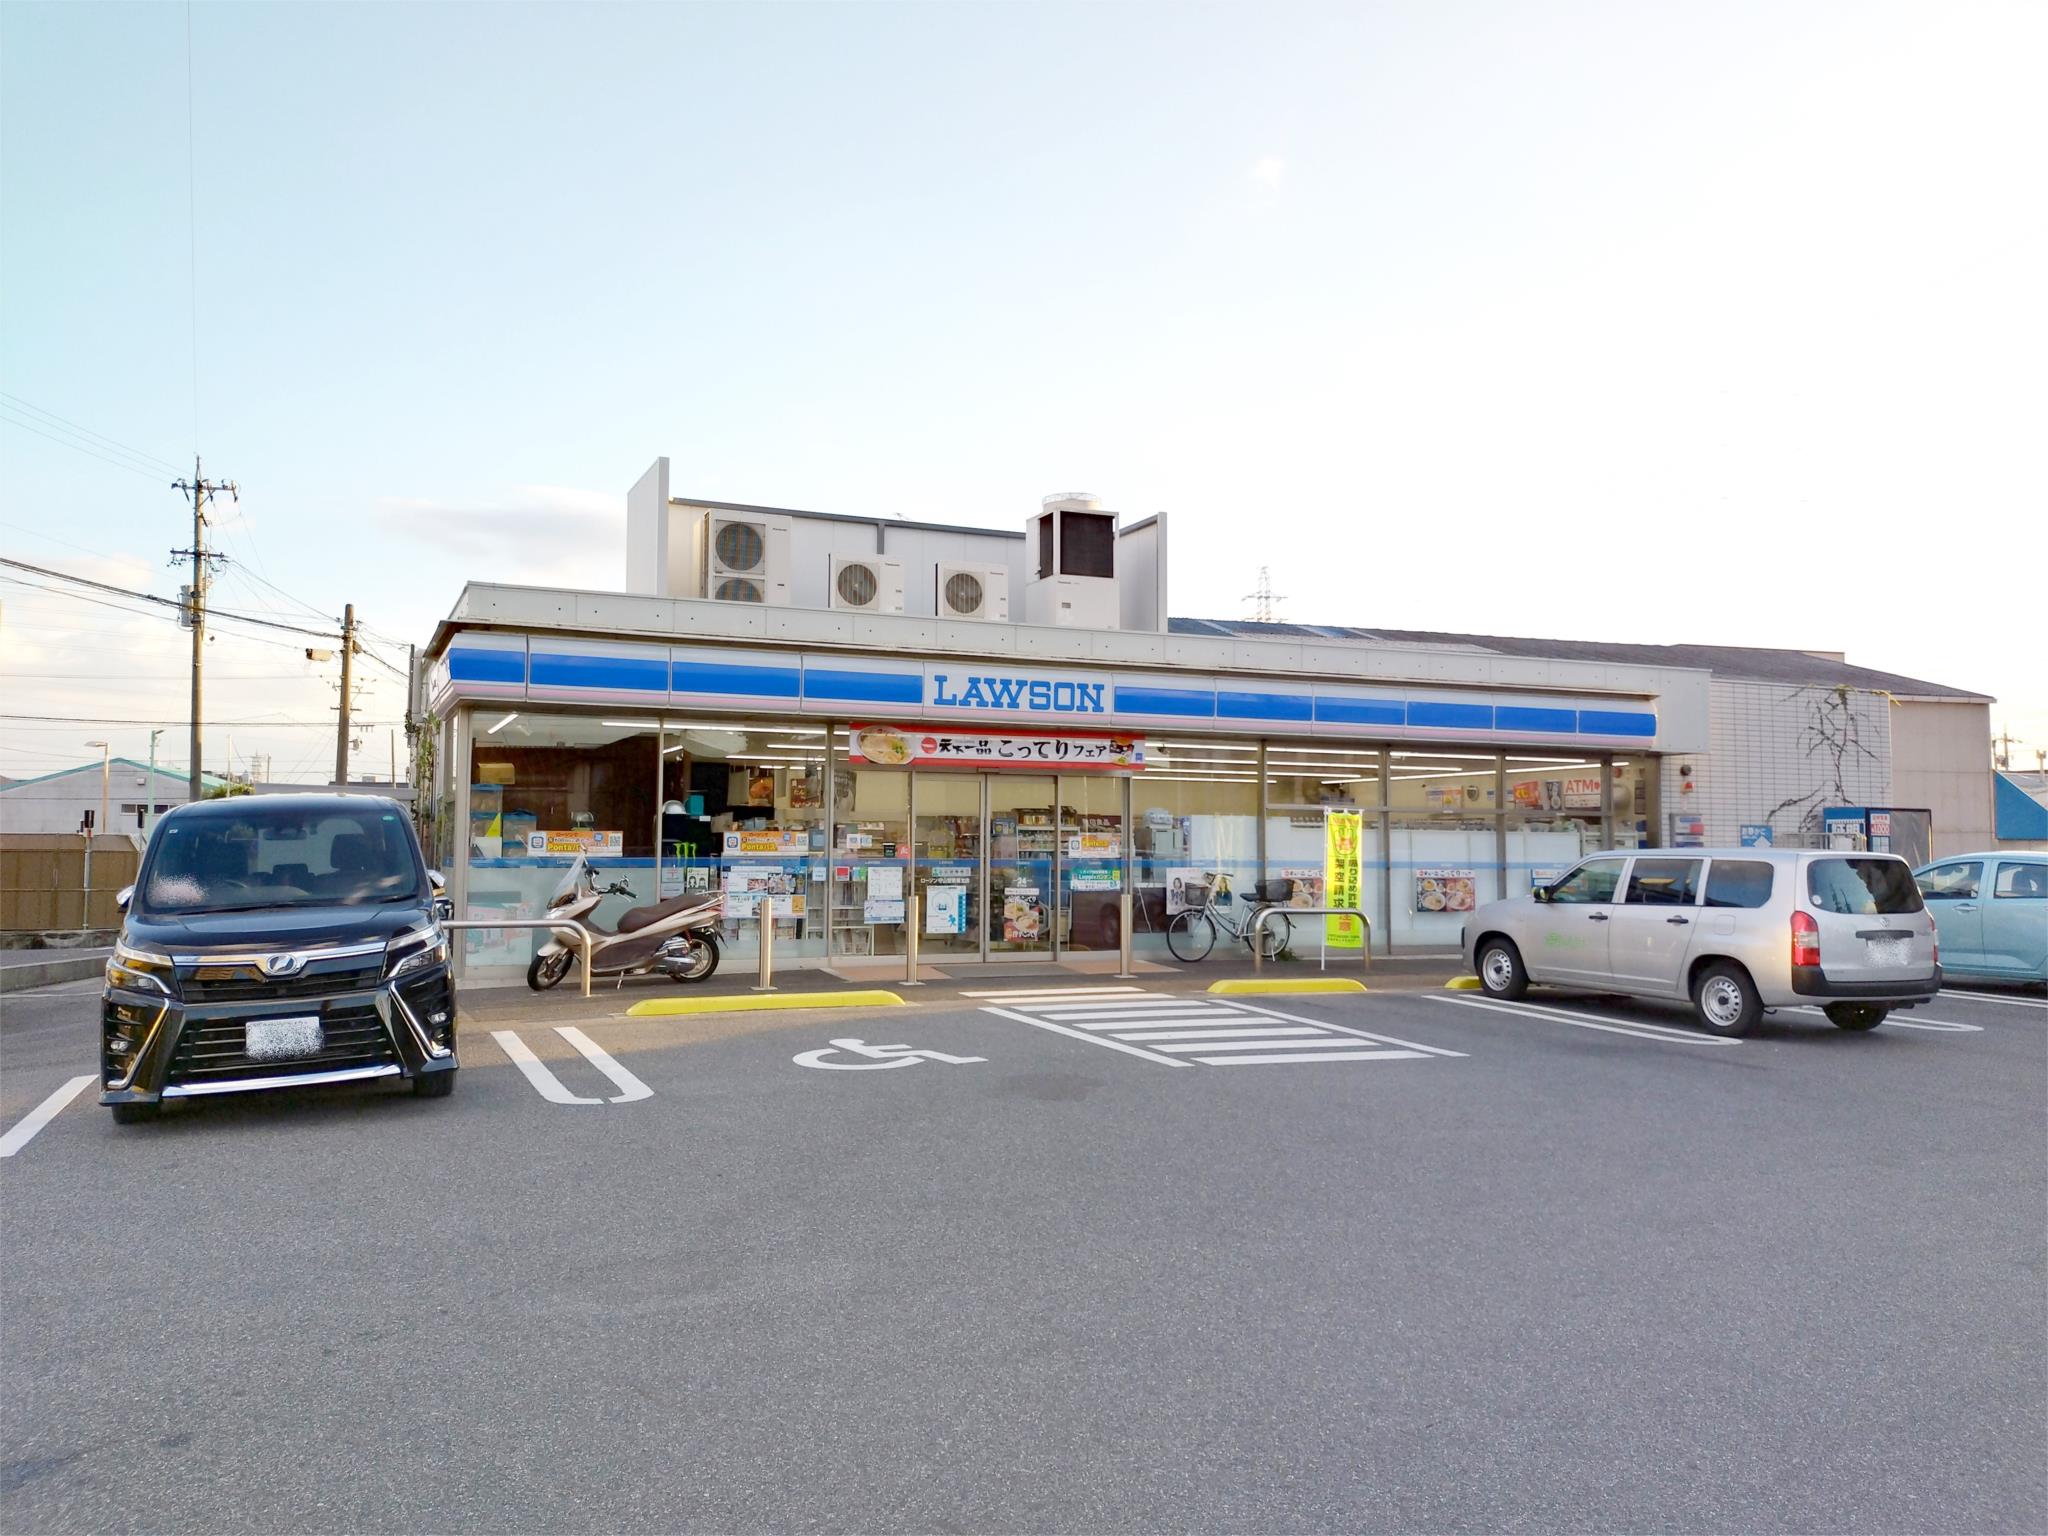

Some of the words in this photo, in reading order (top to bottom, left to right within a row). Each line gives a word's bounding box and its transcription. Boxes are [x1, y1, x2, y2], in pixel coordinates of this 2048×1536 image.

[934, 675, 1105, 713] LAWSON
[939, 738, 992, 755] 天下一品
[998, 739, 1107, 760] こってりフェア
[1566, 779, 1595, 793] ATM
[547, 843, 580, 851] Pontaパ
[1333, 858, 1344, 908] 架空請求
